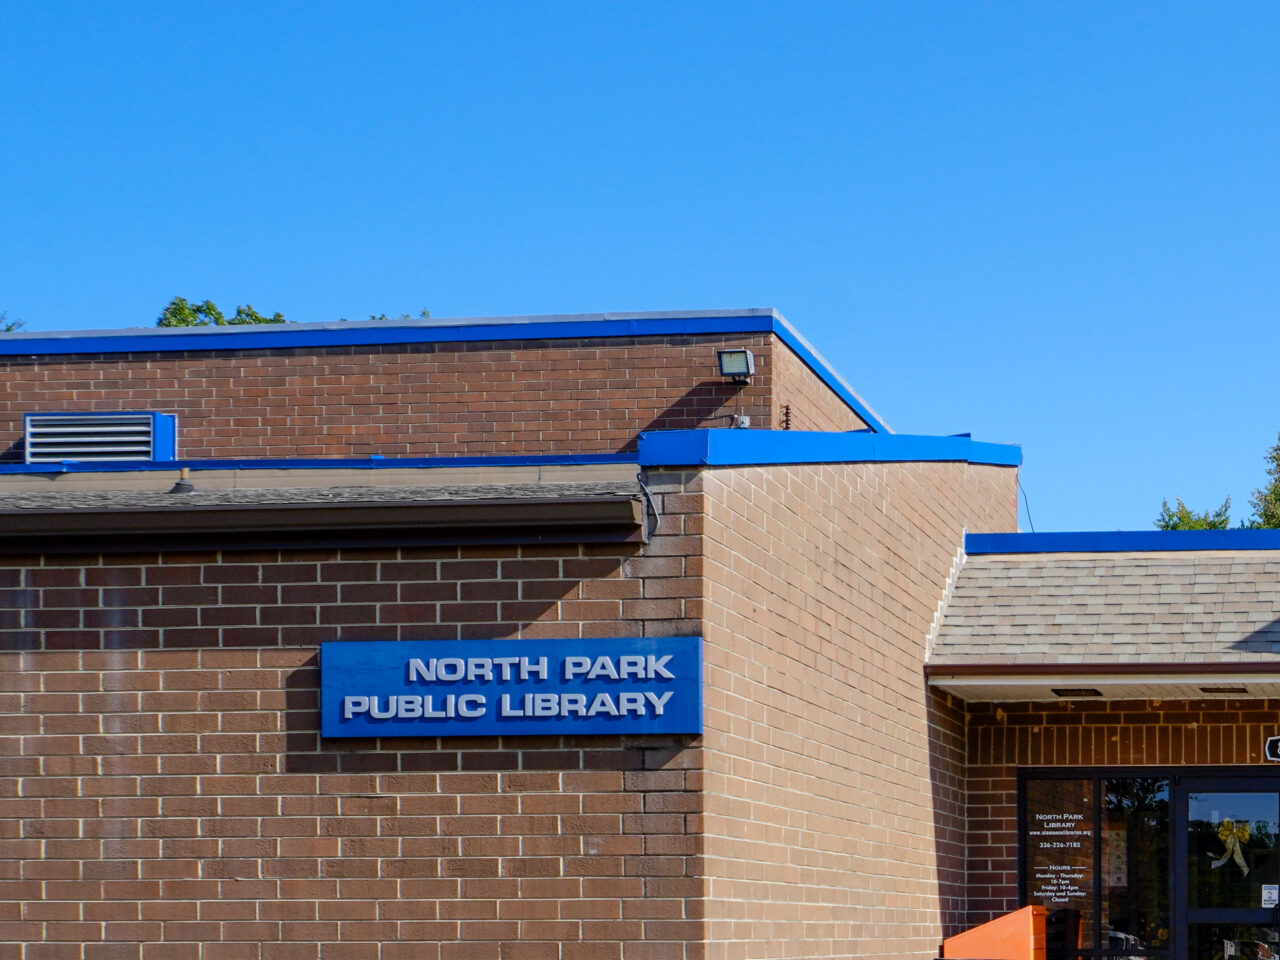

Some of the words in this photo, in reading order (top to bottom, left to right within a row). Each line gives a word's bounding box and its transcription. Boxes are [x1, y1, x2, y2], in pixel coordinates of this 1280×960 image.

[408, 656, 548, 682] NORTH
[564, 655, 675, 680] PARK
[344, 694, 487, 719] PUBLIC
[500, 691, 674, 717] LIBRARY
